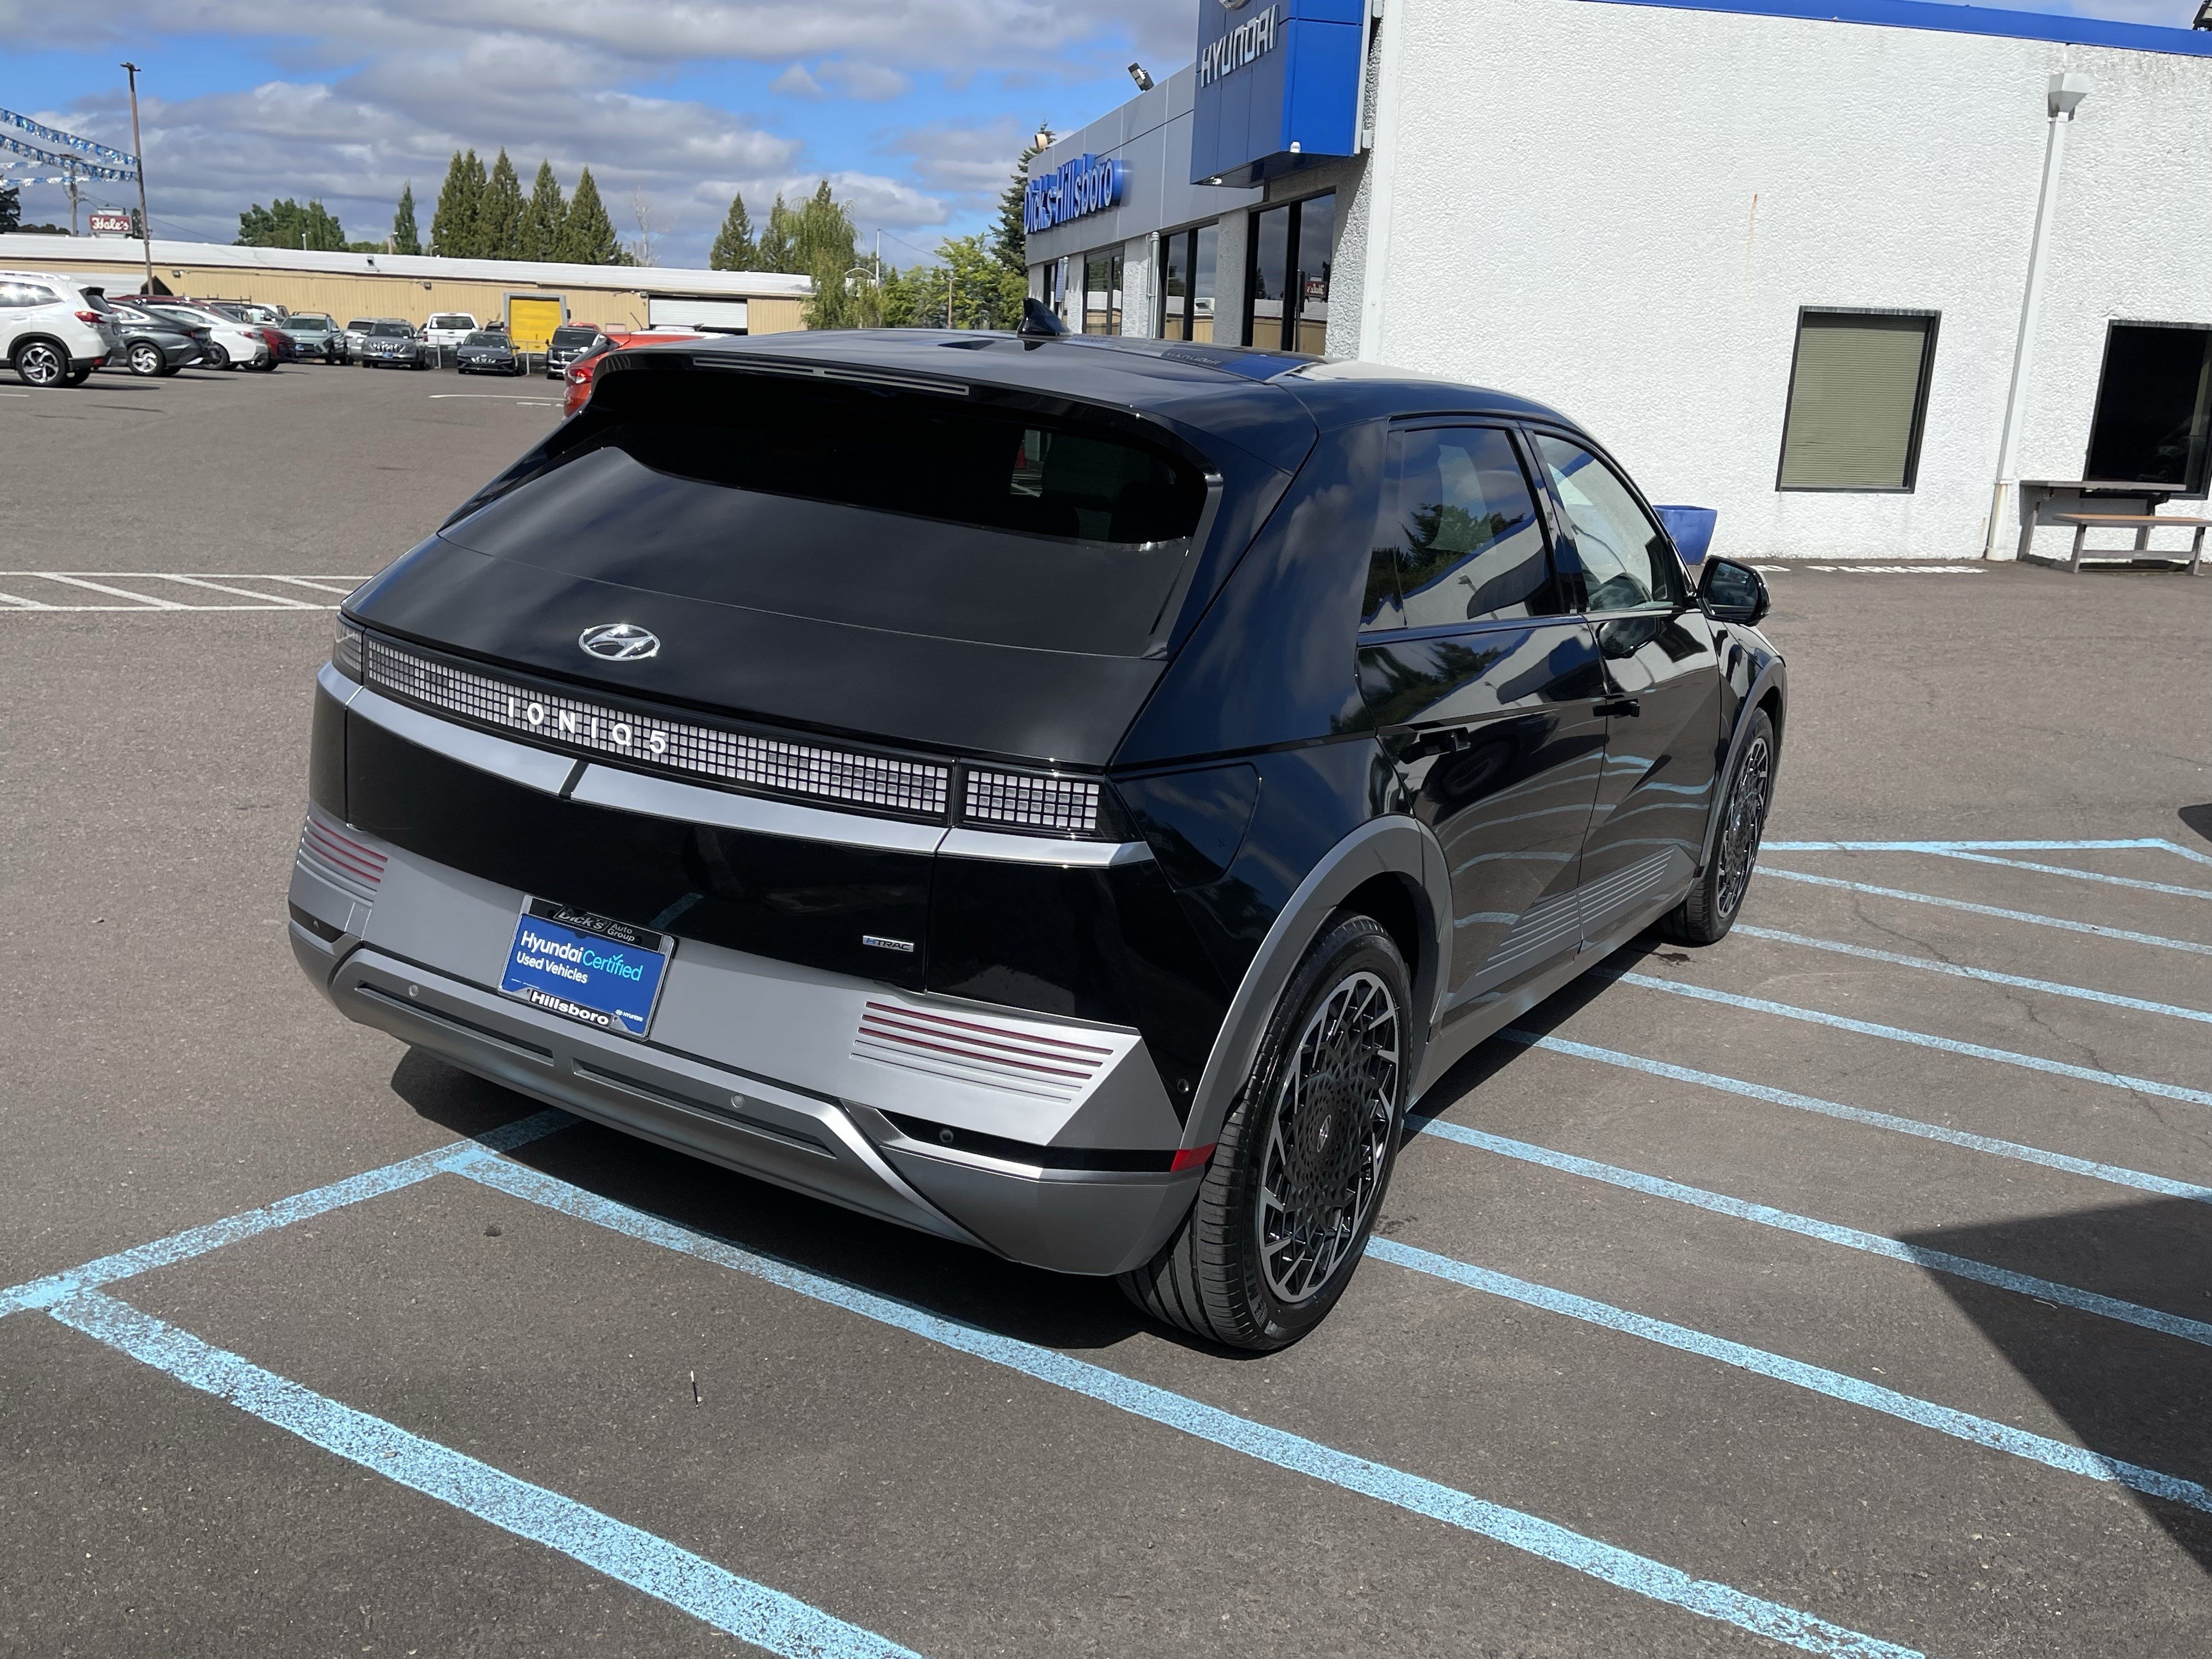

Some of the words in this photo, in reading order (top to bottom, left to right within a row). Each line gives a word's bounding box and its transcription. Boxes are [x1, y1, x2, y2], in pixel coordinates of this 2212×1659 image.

[1201, 3, 1279, 88] HYUNDAI
[1024, 174, 1053, 235] Dick's
[1055, 153, 1117, 224] Hillsboro
[91, 217, 129, 230] Hale's
[508, 696, 631, 747] IONIQ
[649, 730, 667, 754] 5
[607, 928, 635, 942] Group
[610, 923, 633, 934] Auto
[865, 937, 910, 951] HTRAC
[516, 950, 545, 970] Used
[545, 958, 588, 984] Vehicles
[520, 930, 584, 963] Hyundai
[582, 950, 644, 981] Certified
[531, 990, 610, 1025] Hillsboro
